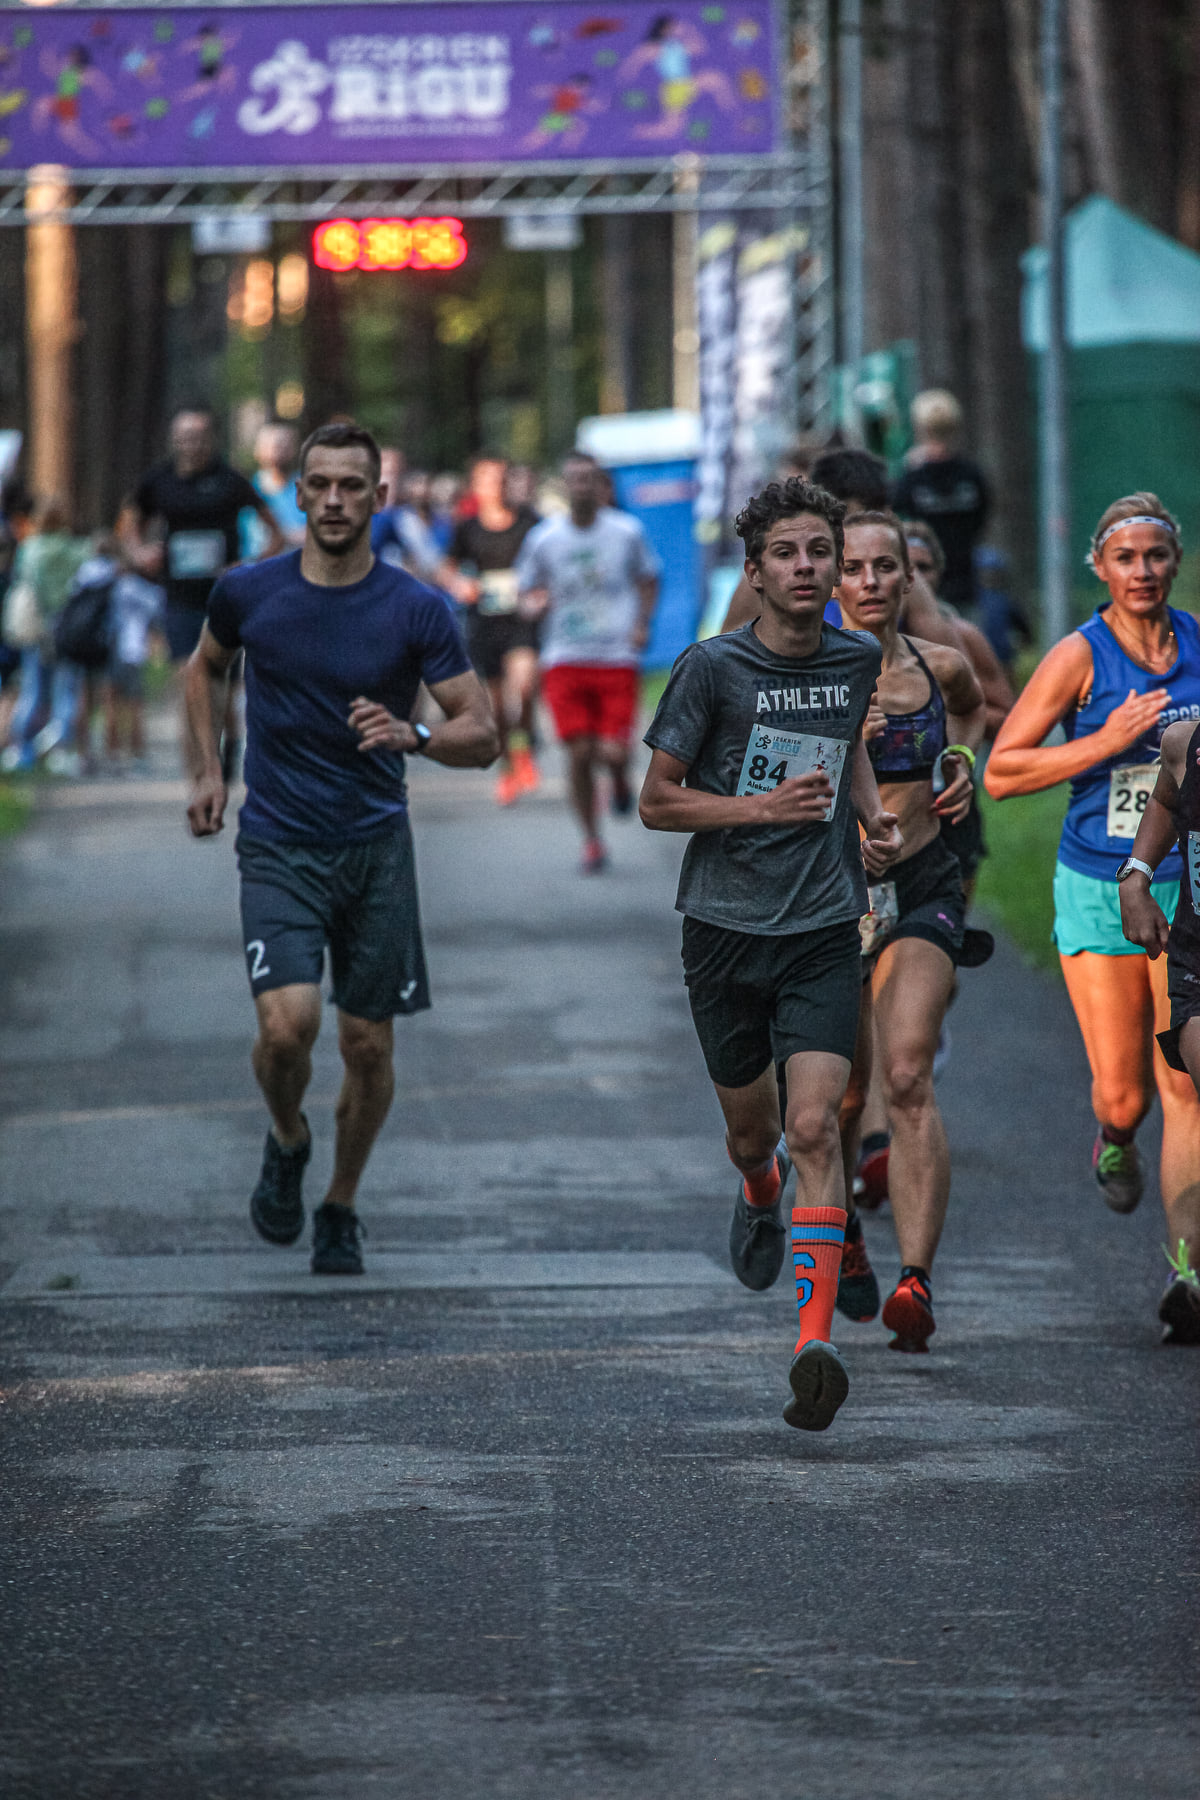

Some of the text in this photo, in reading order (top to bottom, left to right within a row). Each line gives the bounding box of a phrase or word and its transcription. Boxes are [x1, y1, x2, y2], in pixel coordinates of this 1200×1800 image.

[756, 685, 850, 713] ATHLETIC
[748, 754, 789, 787] 84
[247, 938, 271, 981] 2
